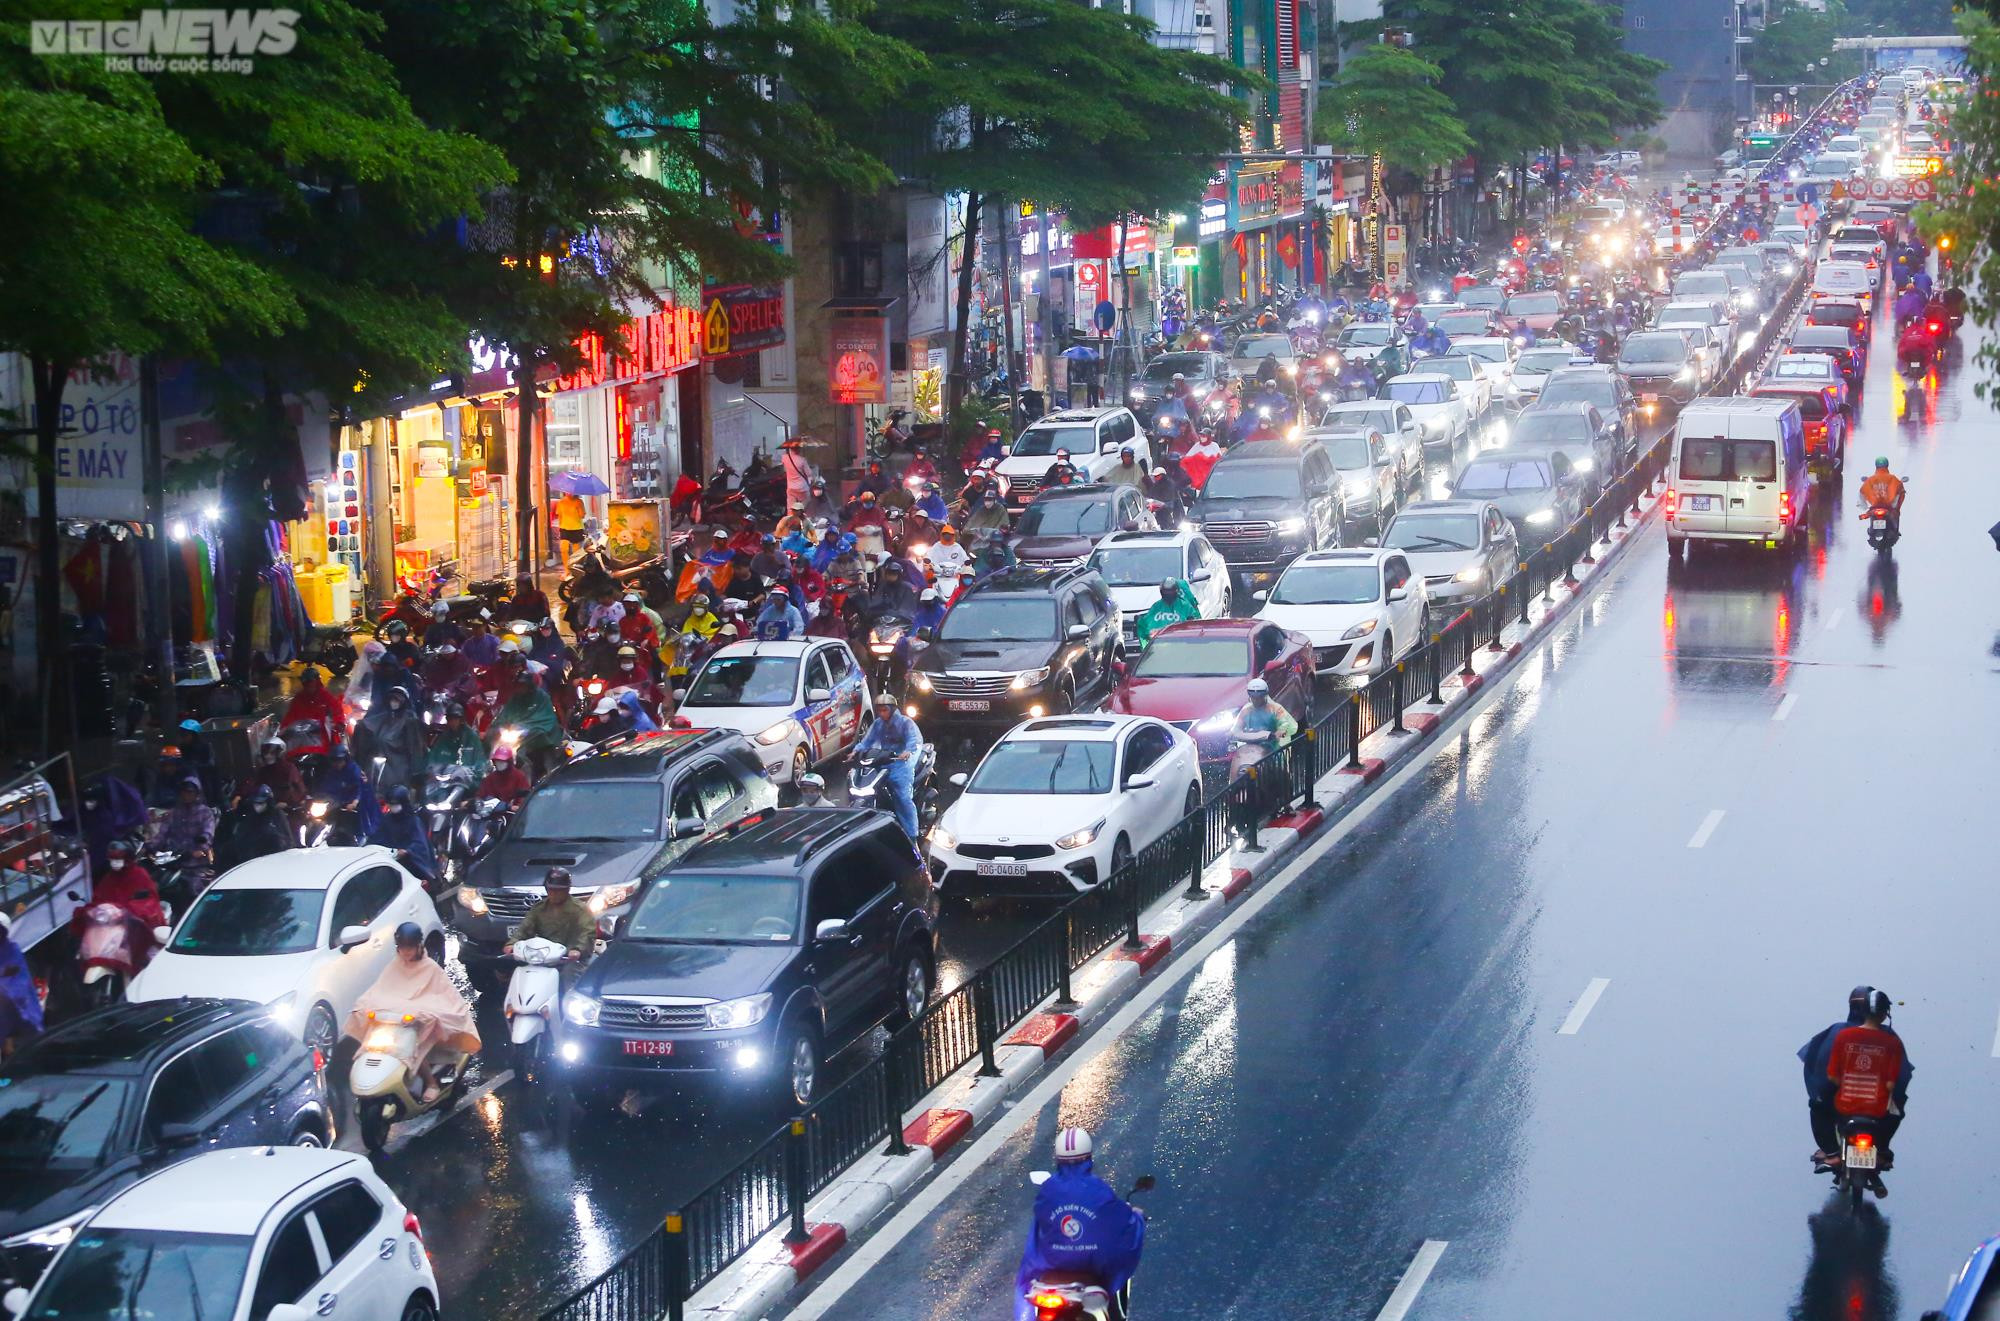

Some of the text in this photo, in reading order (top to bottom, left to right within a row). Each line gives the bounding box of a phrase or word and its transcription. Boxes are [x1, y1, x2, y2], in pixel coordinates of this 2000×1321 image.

[78, 441, 128, 479] MÁY
[978, 864, 1025, 875] 30G-040.66
[624, 1041, 672, 1054] TT-12-89
